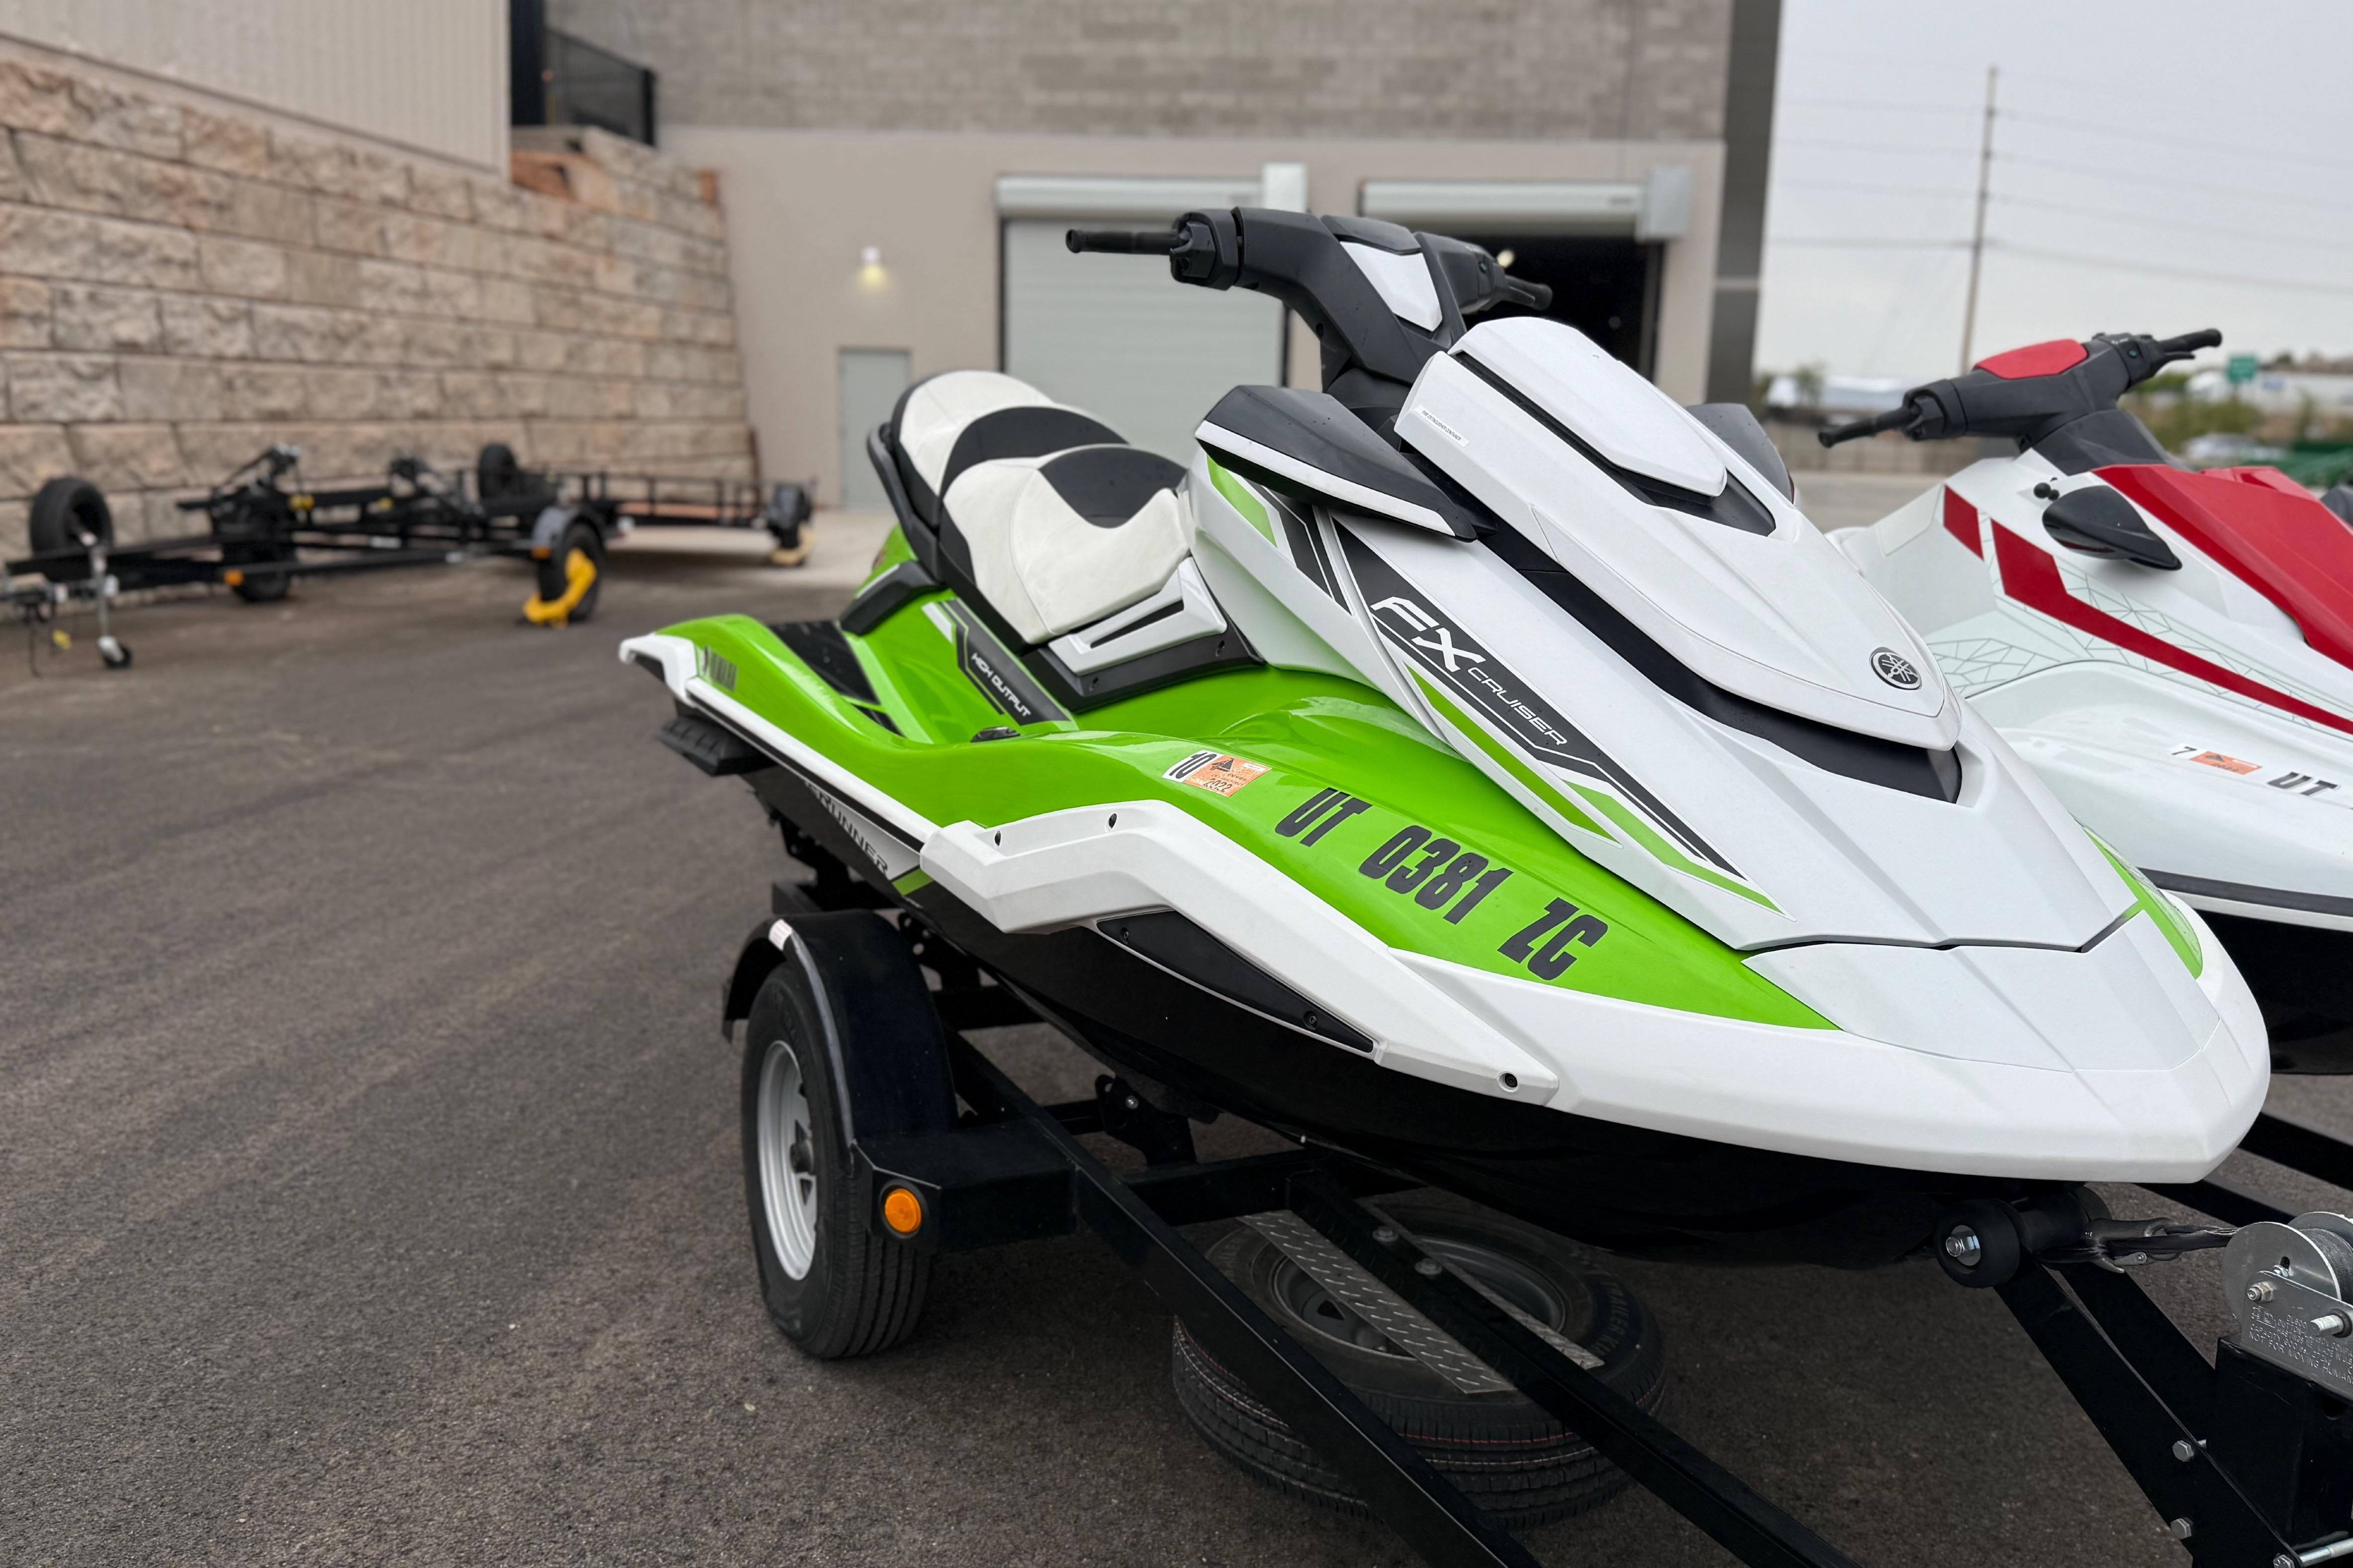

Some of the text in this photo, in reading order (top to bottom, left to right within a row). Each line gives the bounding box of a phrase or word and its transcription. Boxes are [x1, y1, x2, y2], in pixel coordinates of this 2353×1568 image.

[971, 652, 1031, 716] HIGH OUTPUT
[1370, 596, 1568, 746] FX CRUISER
[1168, 752, 1217, 779] 10
[2171, 746, 2197, 756] 7
[1203, 778, 1233, 792] 2022
[2267, 771, 2339, 796] UT
[1275, 787, 1608, 980] UT 0381 ZC
[2249, 1331, 2265, 1344] NOT
[2268, 1339, 2284, 1354] FOR
[2288, 1349, 2319, 1369] MOVING
